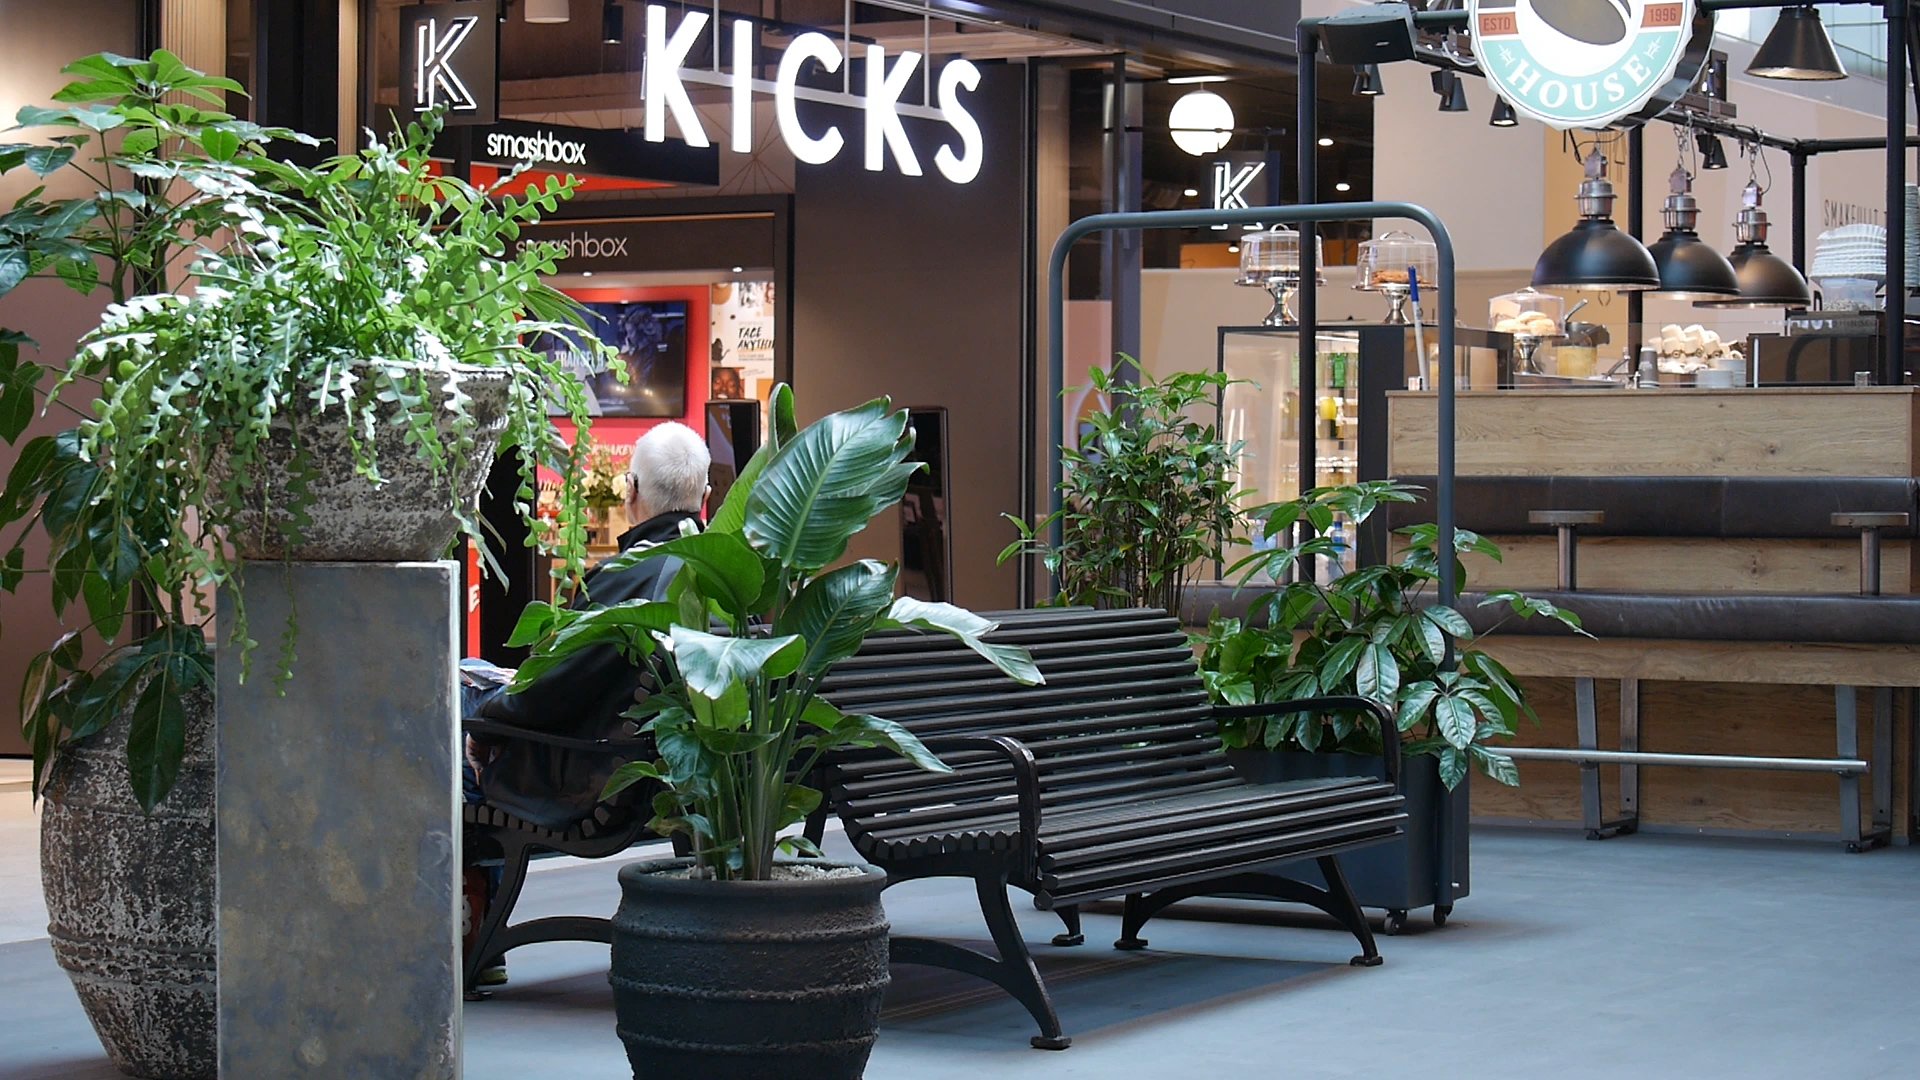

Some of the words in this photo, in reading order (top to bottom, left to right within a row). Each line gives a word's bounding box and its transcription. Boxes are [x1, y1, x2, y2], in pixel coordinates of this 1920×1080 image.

[1483, 17, 1511, 31] ESTD
[1650, 8, 1677, 22] 1996
[413, 15, 479, 112] K
[1506, 54, 1652, 111] HOUSE
[643, 3, 984, 185] KICKS
[487, 130, 587, 165] smashbox
[1210, 161, 1266, 230] K
[516, 231, 628, 258] sshbox
